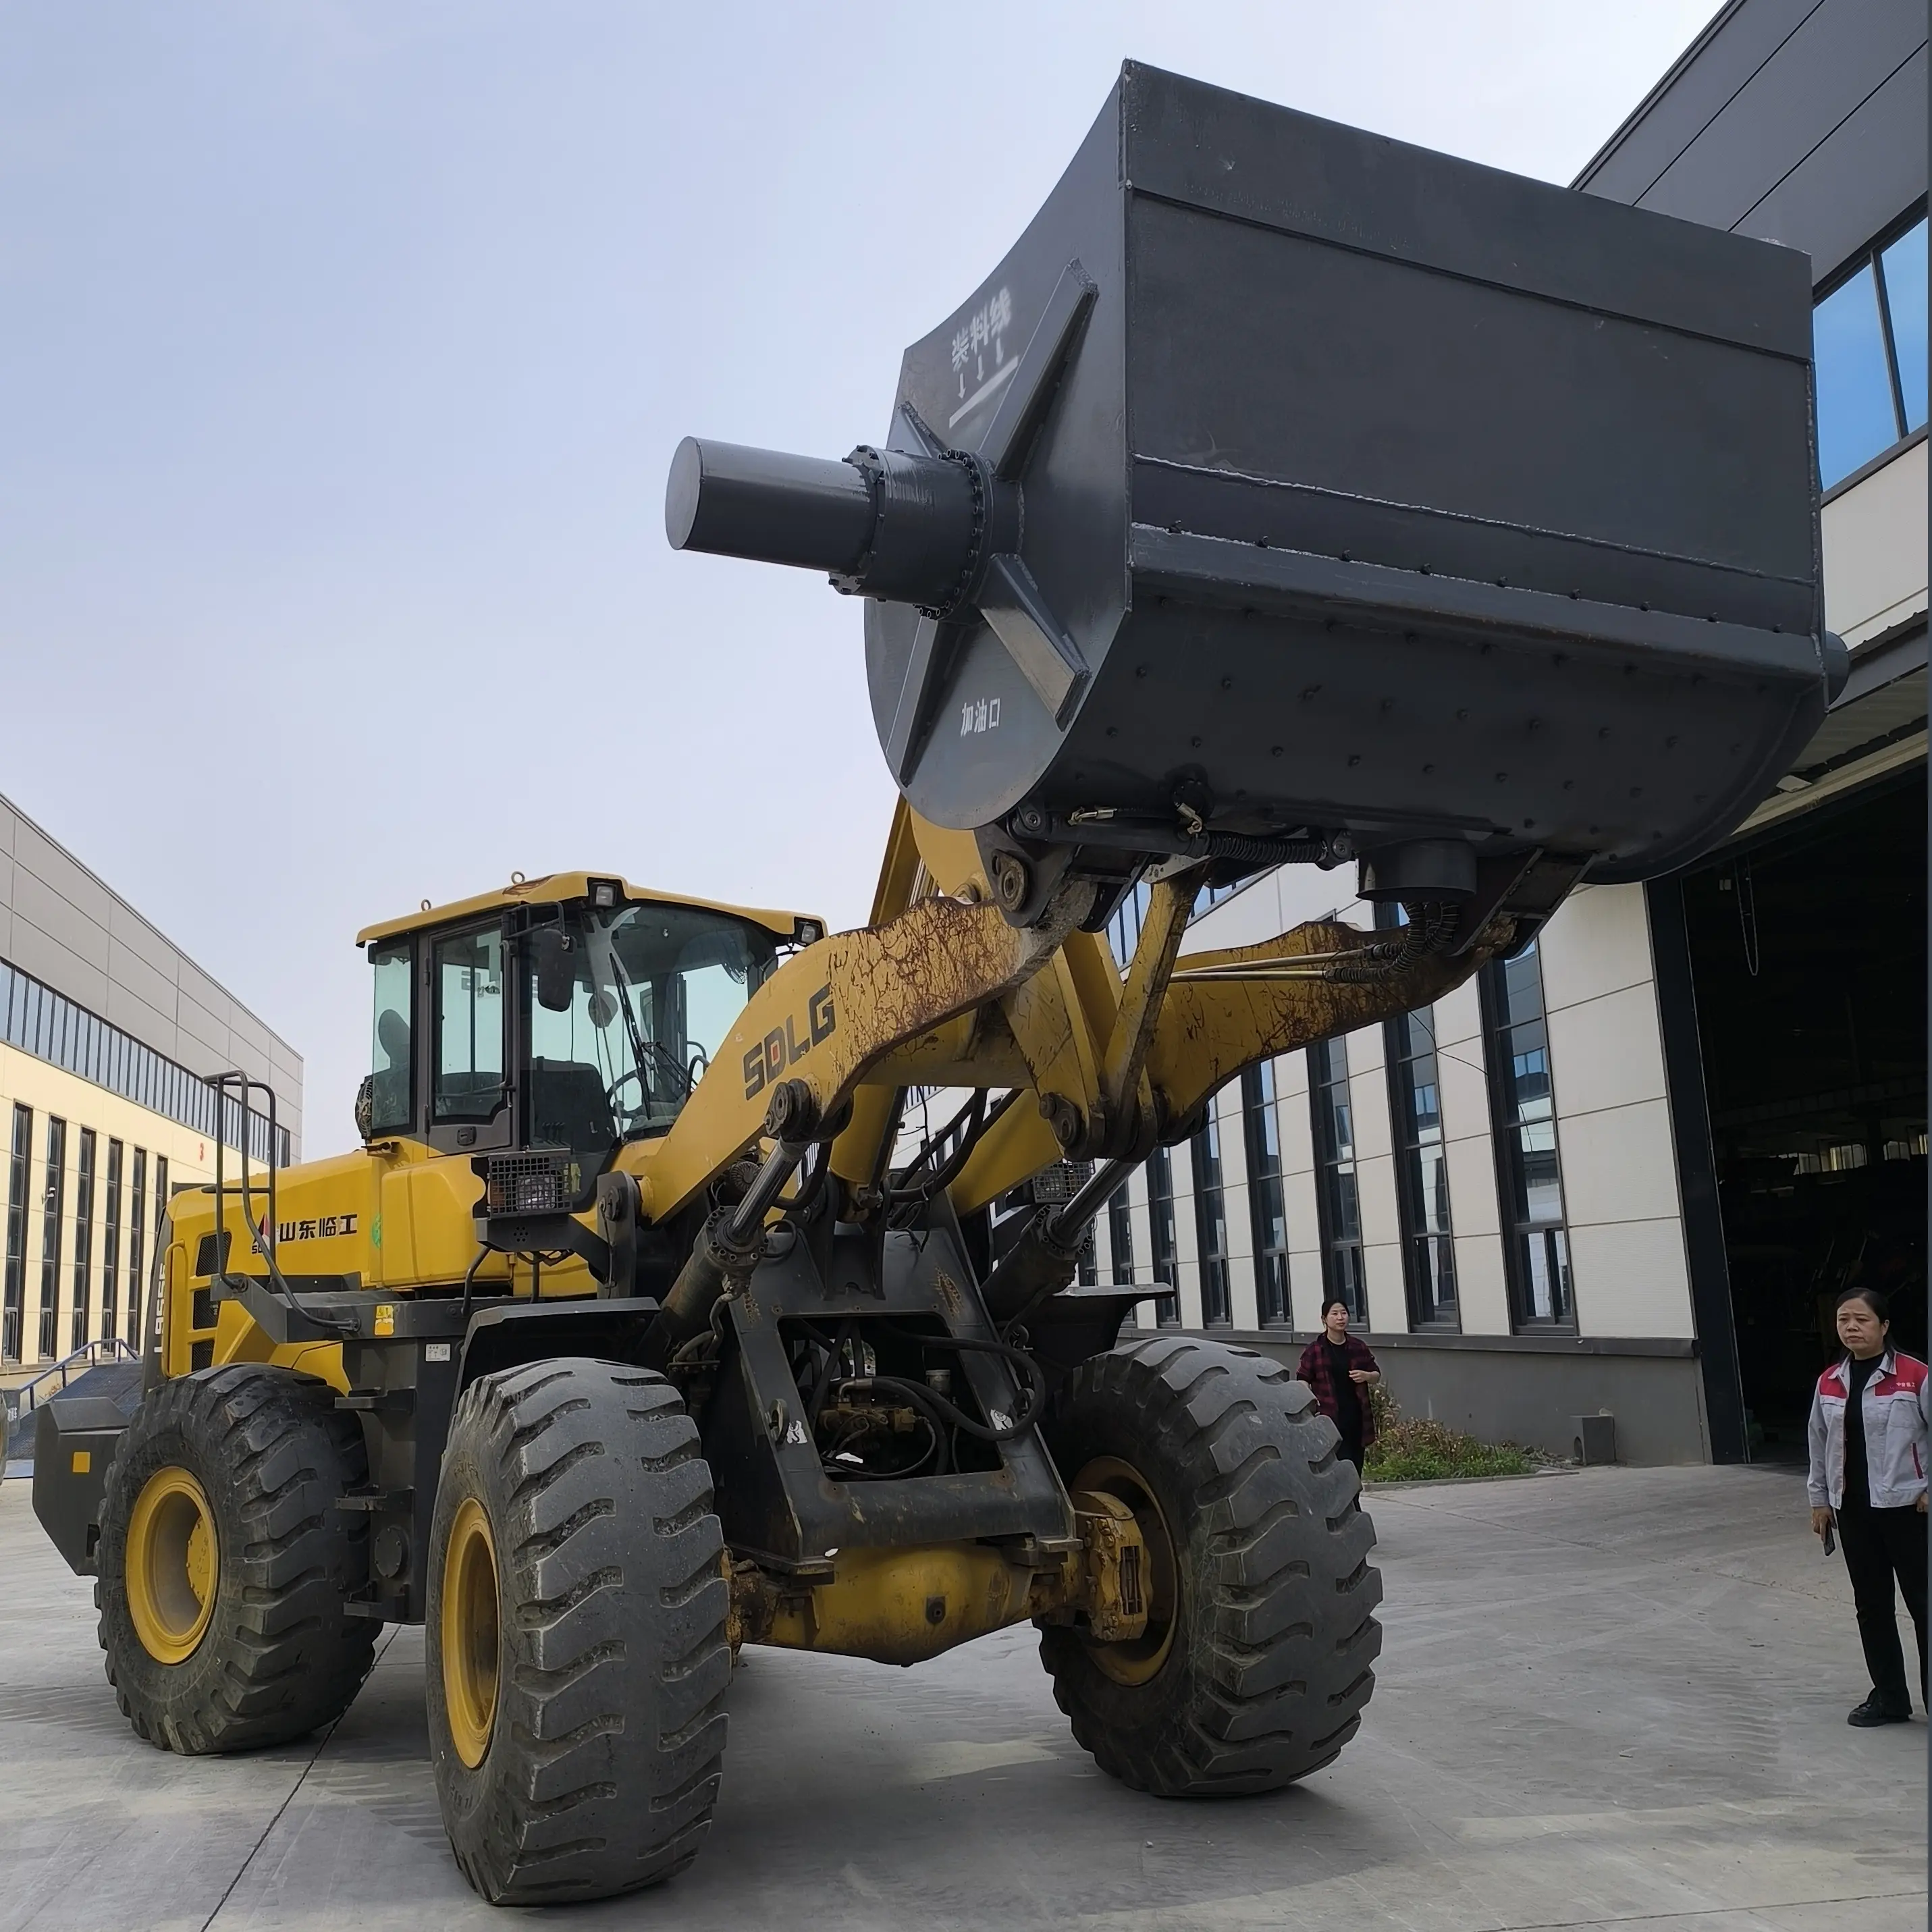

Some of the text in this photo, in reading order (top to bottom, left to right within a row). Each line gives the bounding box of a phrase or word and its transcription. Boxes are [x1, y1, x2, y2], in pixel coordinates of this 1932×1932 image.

[961, 697, 1000, 737] 加油口
[743, 982, 836, 1100] SDLG
[279, 1214, 358, 1242] 山东临工
